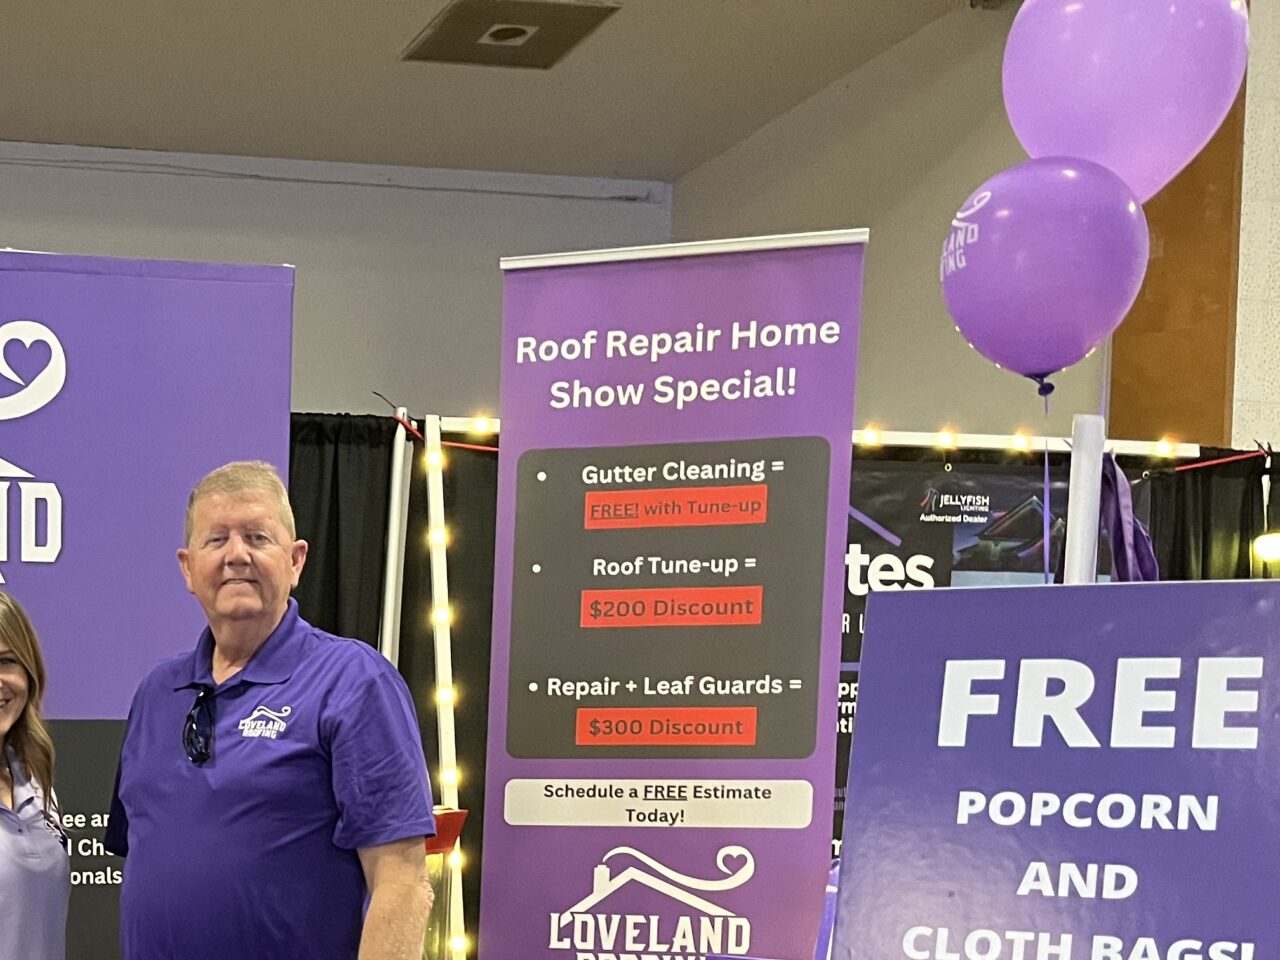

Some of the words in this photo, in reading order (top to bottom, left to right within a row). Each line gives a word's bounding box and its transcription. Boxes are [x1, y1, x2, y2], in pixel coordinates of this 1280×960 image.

[516, 329, 598, 364] Roof
[606, 322, 722, 363] Repair
[730, 320, 841, 351] Home
[549, 379, 645, 410] Show
[653, 366, 797, 411] Special!
[581, 464, 657, 484] Gutter
[662, 458, 766, 482] Cleaning
[589, 502, 640, 521] FREE!
[644, 499, 682, 516] with
[687, 499, 762, 516] Tune-up
[939, 494, 990, 508] JELLYFISH
[919, 513, 962, 523] Authorized
[962, 513, 988, 524] Dealer
[592, 556, 644, 576] Roof
[647, 556, 739, 577] Tune-up
[589, 600, 647, 620] $200
[653, 598, 755, 617] Discount
[547, 677, 621, 700] Repair
[643, 676, 695, 696] Leaf
[699, 675, 783, 695] Guards
[937, 655, 1264, 750] FREE
[238, 719, 287, 732] LOVELAND
[589, 718, 643, 737] $300
[649, 718, 744, 736] Discount
[543, 784, 624, 799] Schedule
[628, 788, 639, 799] a
[642, 785, 688, 801] FREE
[692, 785, 772, 800] Estimate
[625, 808, 686, 827] Today!
[955, 790, 1220, 831] POPCORN
[1015, 861, 1139, 900] AND
[548, 913, 751, 955] LOVELAND
